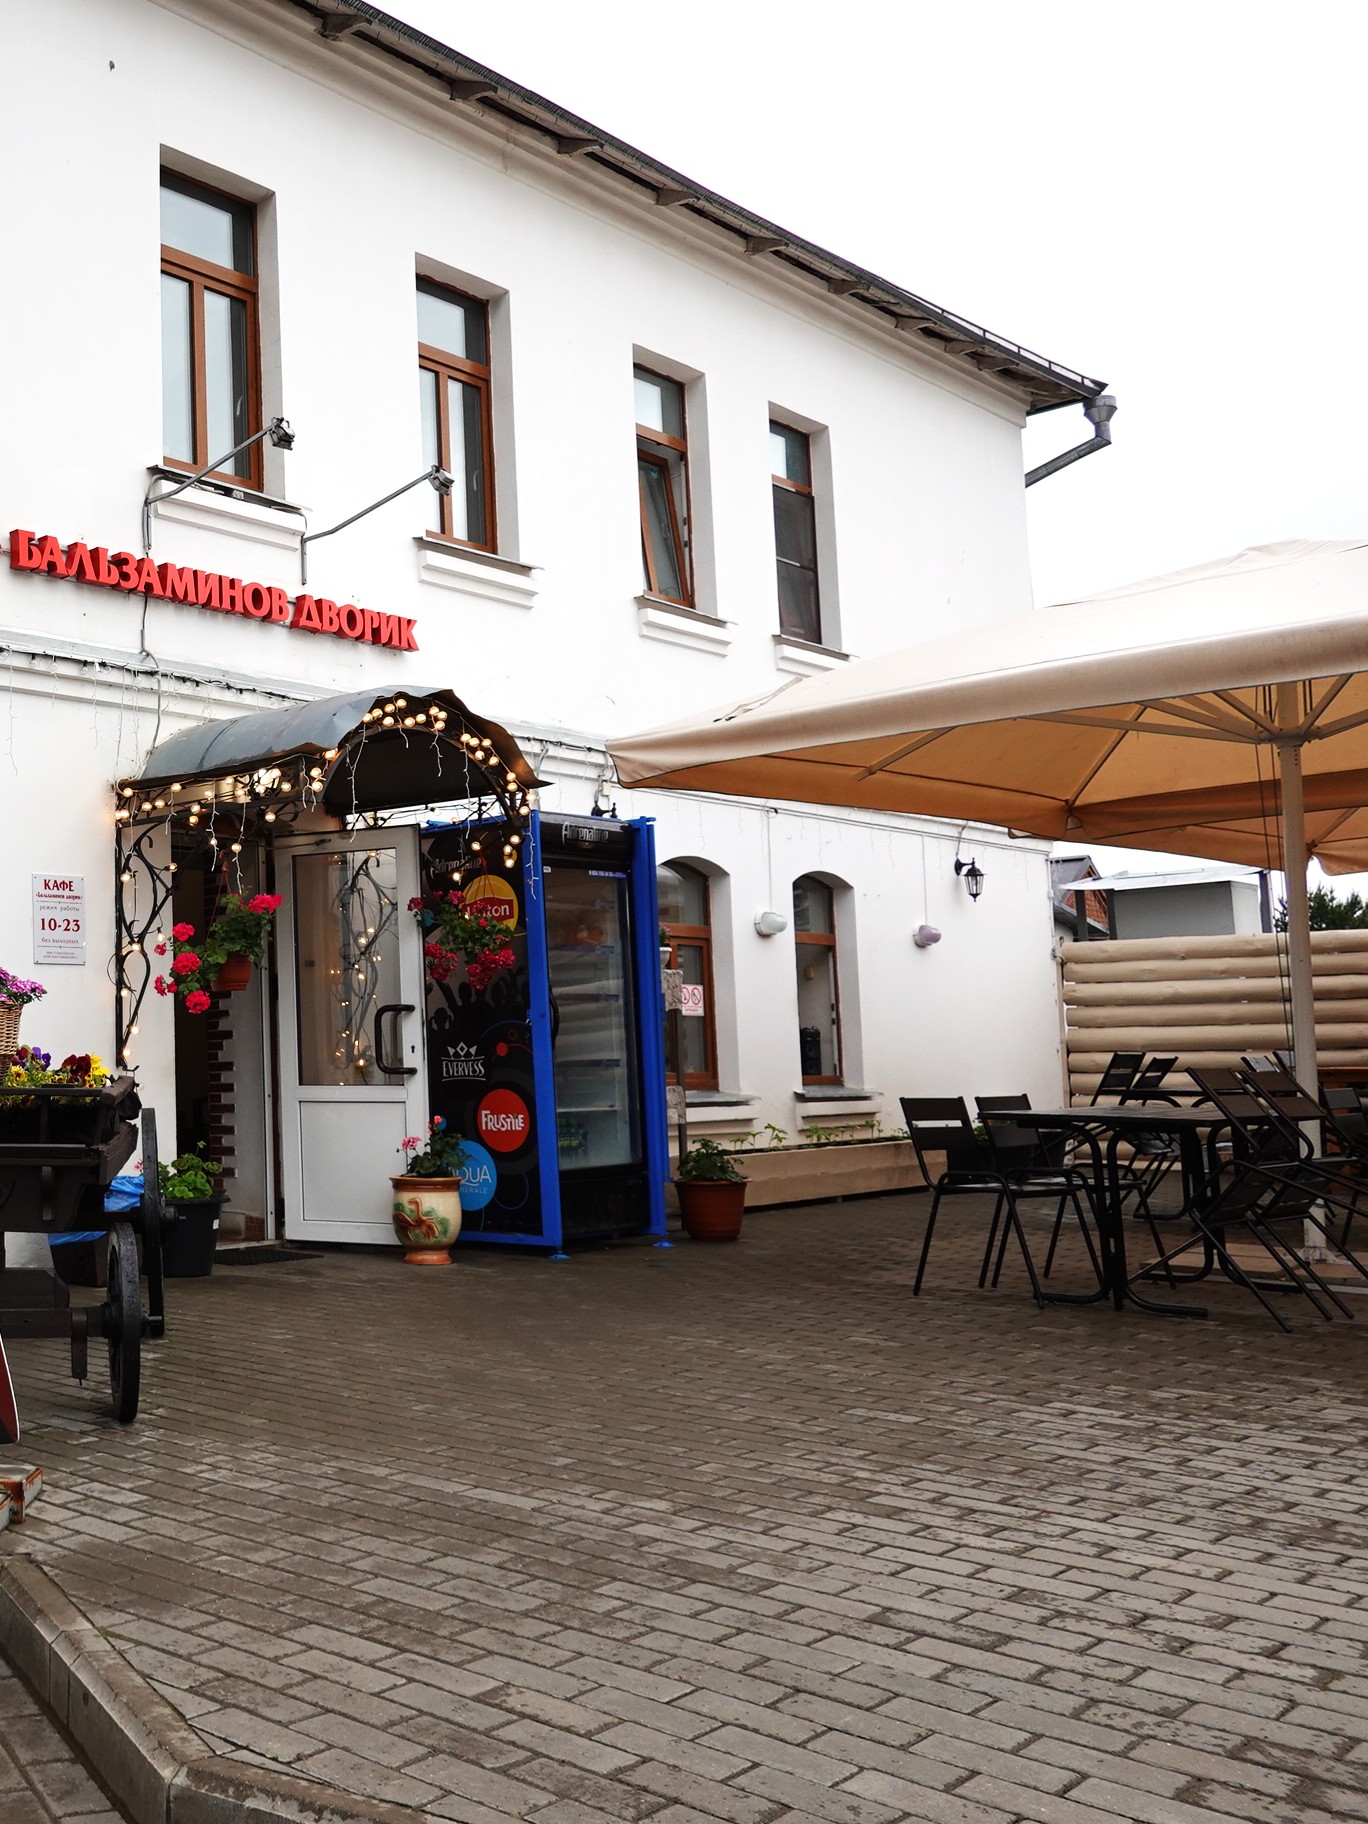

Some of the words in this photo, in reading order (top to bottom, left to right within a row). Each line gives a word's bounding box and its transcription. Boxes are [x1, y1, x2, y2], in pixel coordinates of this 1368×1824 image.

[9, 528, 289, 623] БАЛЬЗАМИНОВ
[291, 594, 419, 652] ДВОРИК
[44, 879, 74, 891] КАФЕ
[41, 918, 80, 932] 10-23
[443, 1060, 485, 1077] EVERVESS
[449, 1165, 492, 1187] QUA
